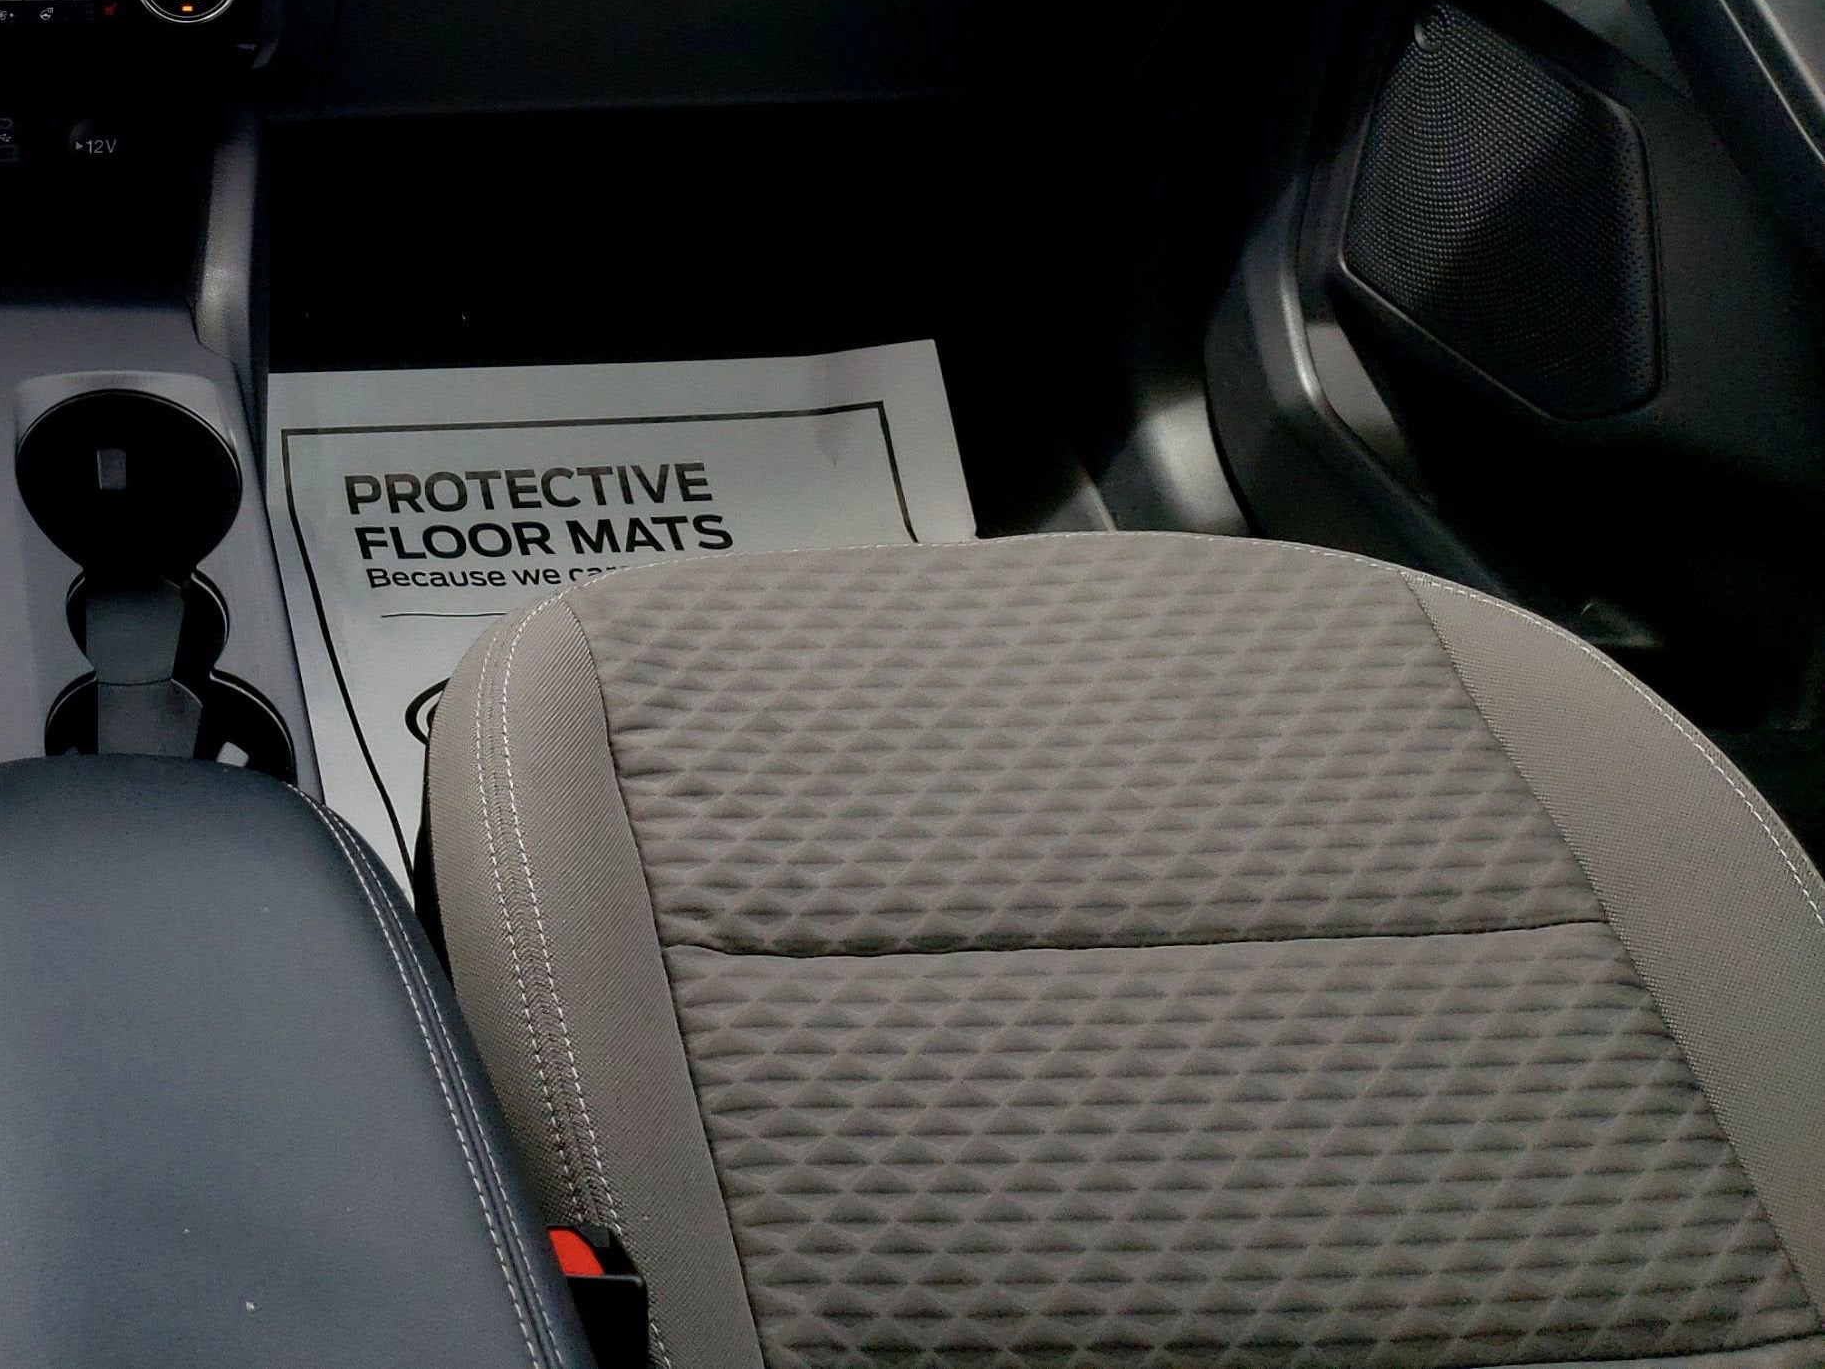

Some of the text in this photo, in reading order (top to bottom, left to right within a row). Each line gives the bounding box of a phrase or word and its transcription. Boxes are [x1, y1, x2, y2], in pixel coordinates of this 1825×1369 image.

[86, 139, 117, 153] 12V
[343, 461, 713, 515] PROTECTIVE
[354, 513, 734, 561] FLOOR MATS
[366, 568, 506, 588] Because
[512, 567, 562, 585] we
